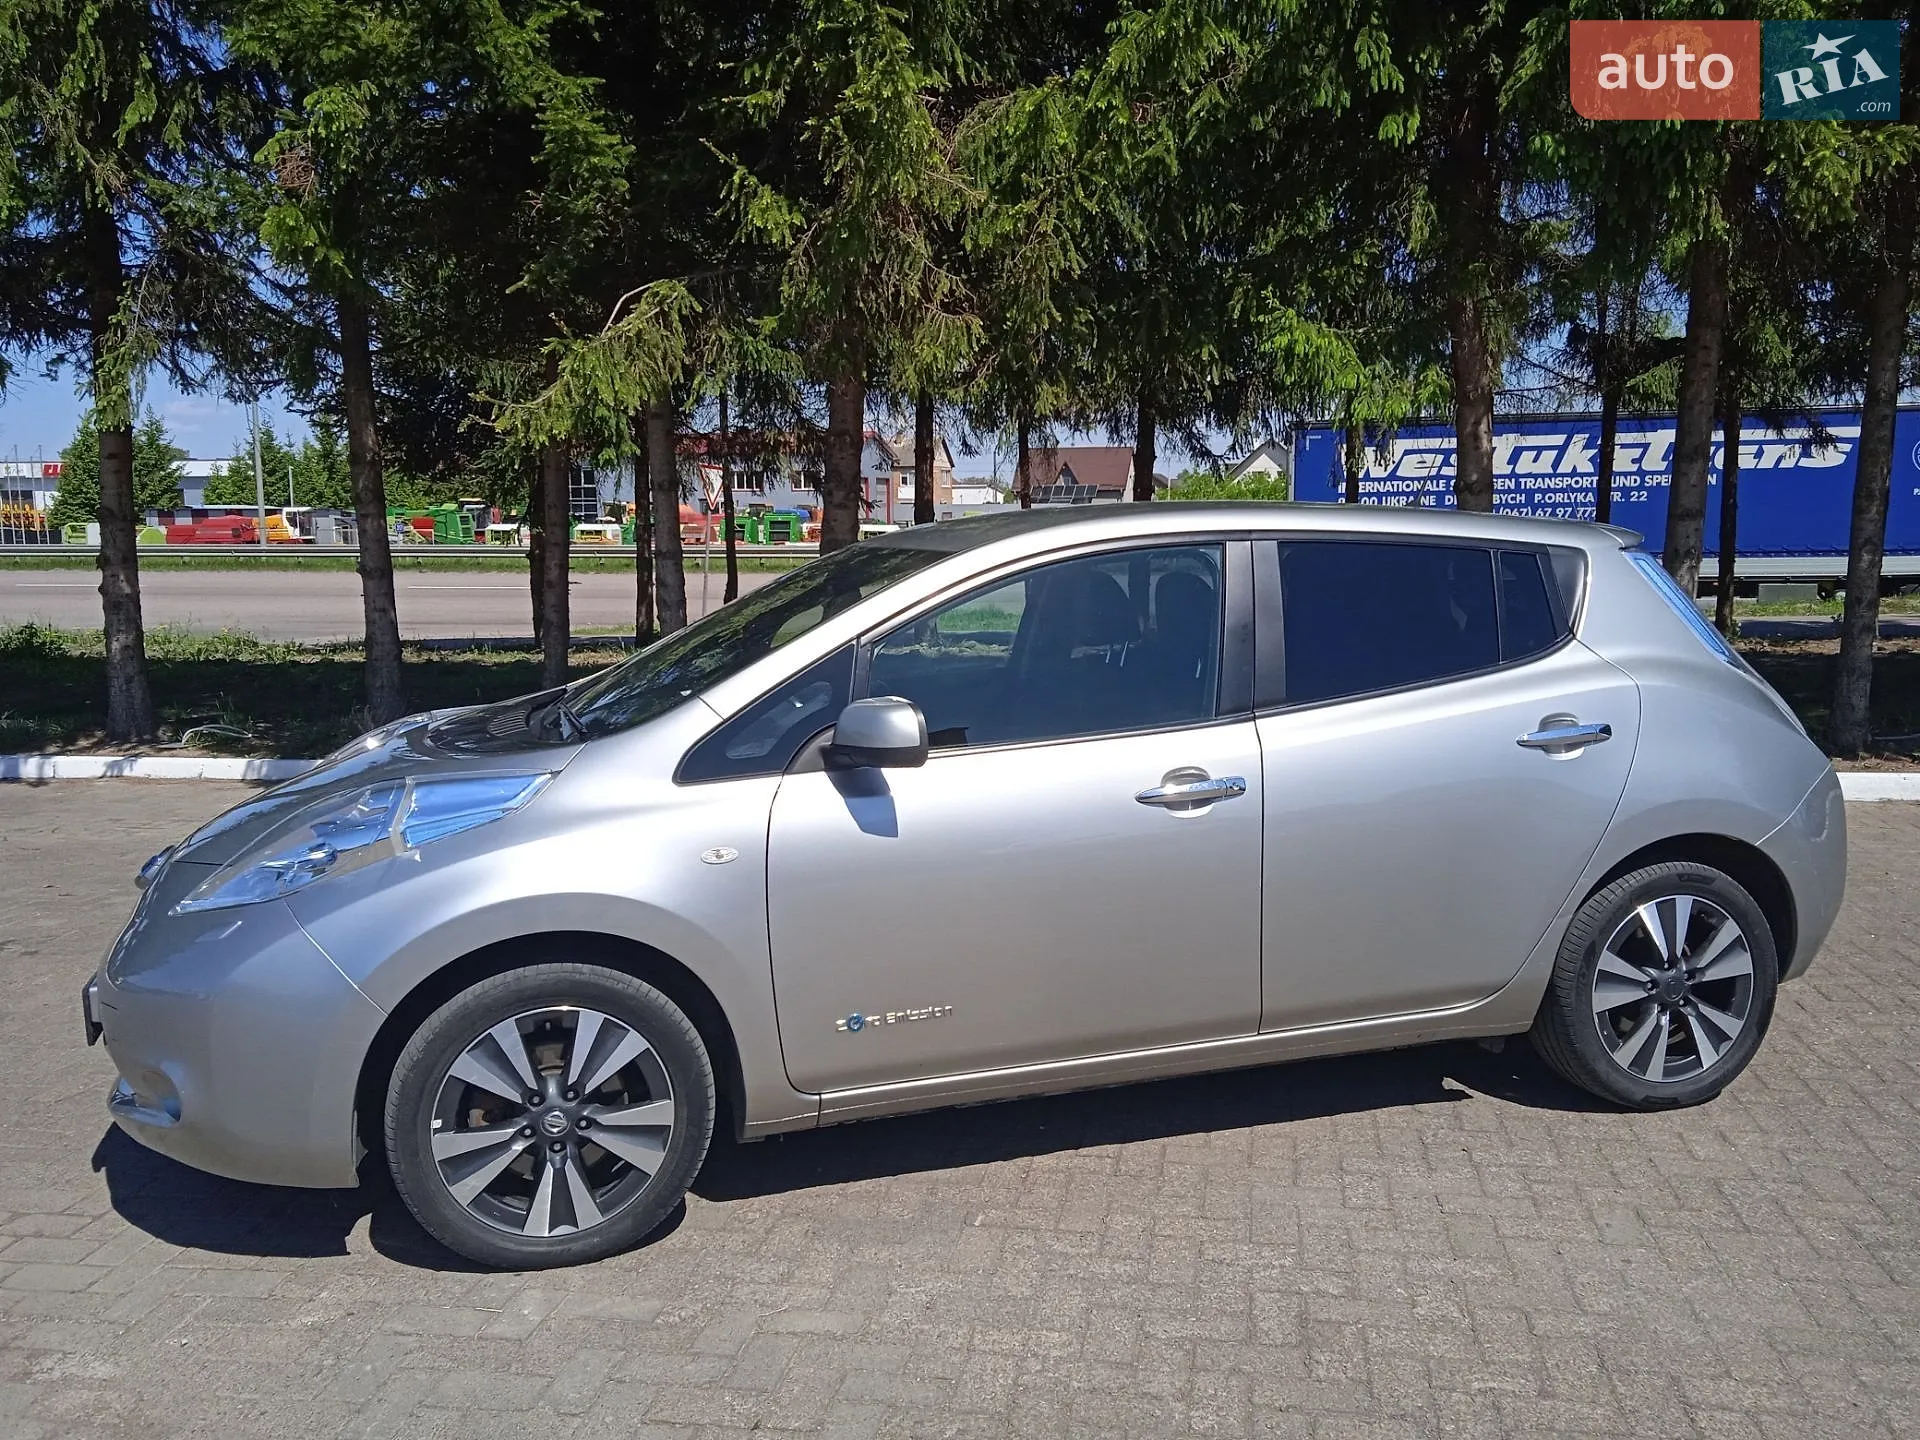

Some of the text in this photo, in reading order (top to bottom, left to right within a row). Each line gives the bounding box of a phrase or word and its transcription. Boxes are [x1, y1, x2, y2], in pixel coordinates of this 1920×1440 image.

[1338, 479, 1446, 493] IERNATIONALE
[1519, 476, 1599, 489] TRANSPORT
[1611, 475, 1641, 487] UND
[1534, 492, 1595, 504] P.ORLYKA
[1629, 490, 1648, 501] 22
[1555, 507, 1573, 519] 97
